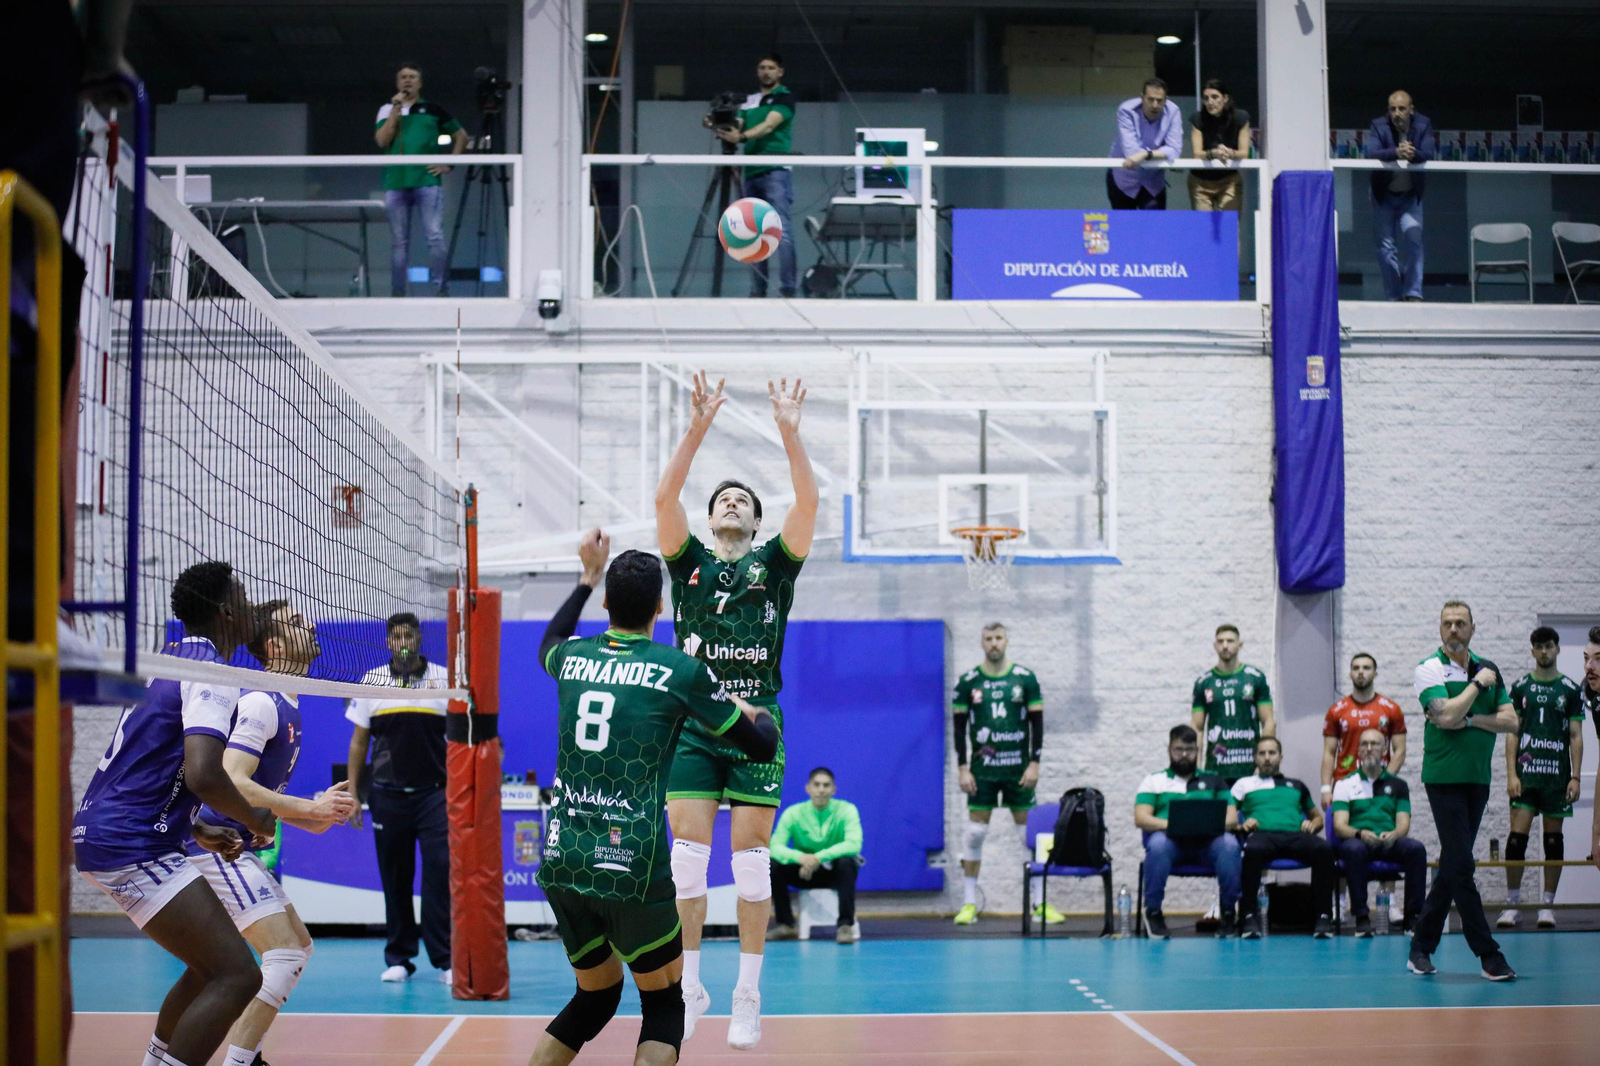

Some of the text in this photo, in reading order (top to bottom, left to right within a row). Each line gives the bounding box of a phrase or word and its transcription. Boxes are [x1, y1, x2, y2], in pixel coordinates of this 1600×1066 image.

[1003, 260, 1189, 278] DIPUTACIÓN DE ALMERÍA
[714, 590, 731, 614] 7
[705, 643, 768, 665] Unicaja
[559, 656, 674, 693] FERNÁNDEZ
[747, 678, 761, 688] DE
[991, 701, 1007, 719] 14
[1223, 698, 1236, 717] 11
[1539, 706, 1545, 724] 1
[575, 690, 616, 753] 8
[1530, 738, 1565, 752] Unicaja
[1527, 764, 1560, 775] ALMERÍA
[501, 791, 533, 800] ONDO
[564, 783, 633, 811] Andalucía
[594, 845, 635, 857] DIPUTACIÓN
[605, 853, 633, 863] ALMERÍA
